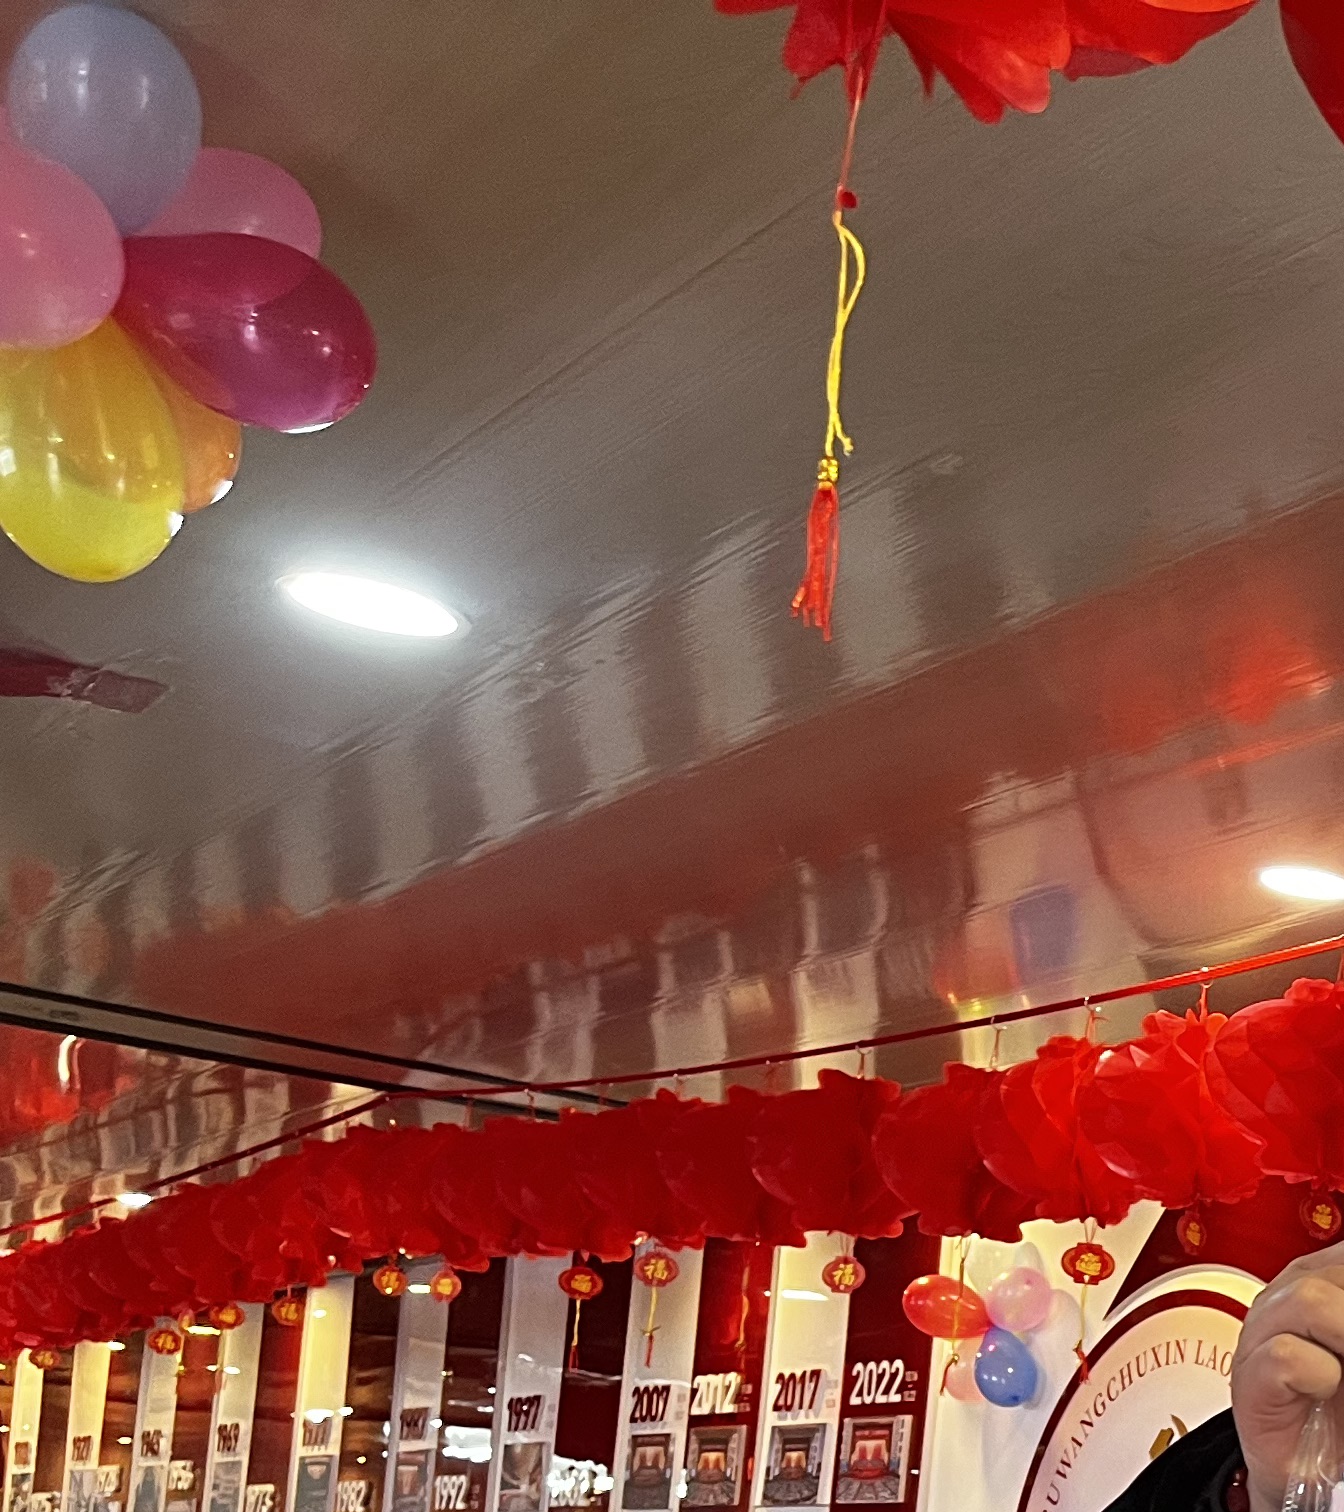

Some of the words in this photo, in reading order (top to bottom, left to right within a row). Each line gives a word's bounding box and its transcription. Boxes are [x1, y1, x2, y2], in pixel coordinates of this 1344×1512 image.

[832, 1264, 855, 1286] 福
[690, 1372, 738, 1415] 2012
[773, 1369, 823, 1412] 2017
[849, 1359, 904, 1405] 2022
[629, 1384, 671, 1423] 2007
[433, 1474, 468, 1510] 1992
